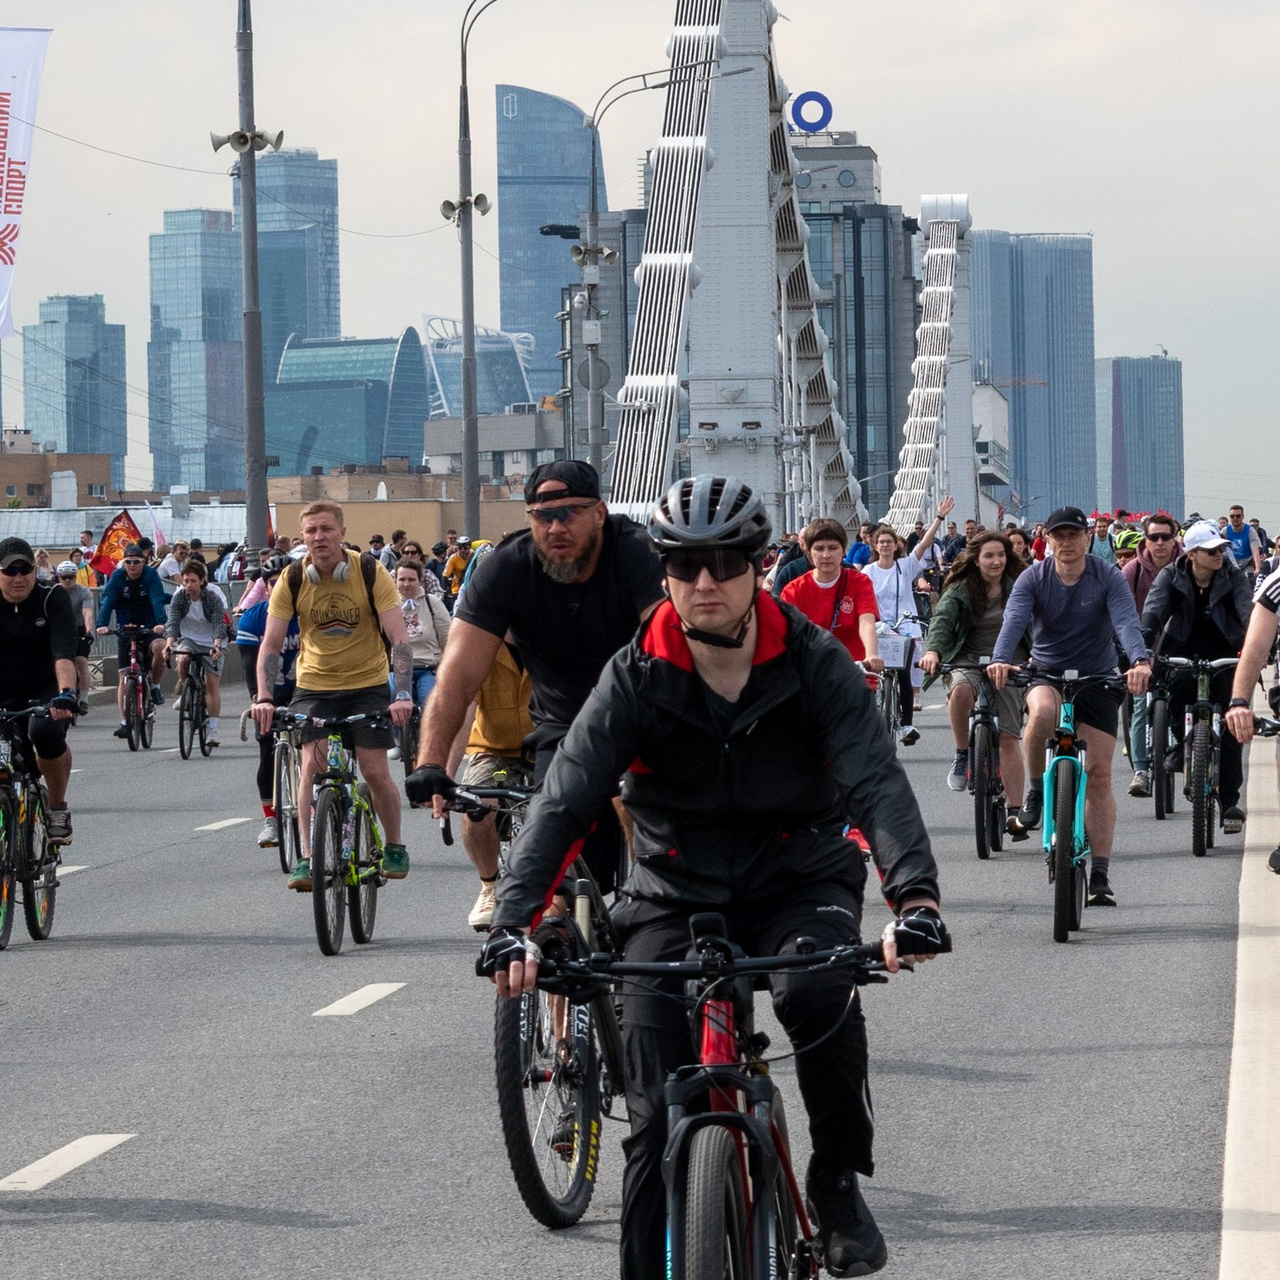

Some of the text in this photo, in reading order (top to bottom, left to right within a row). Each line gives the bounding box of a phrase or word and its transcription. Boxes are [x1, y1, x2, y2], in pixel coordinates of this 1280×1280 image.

[4, 157, 26, 215] СПОРТ
[310, 607, 361, 625] QUIKSILVER
[585, 1120, 598, 1181] MAXXIS
